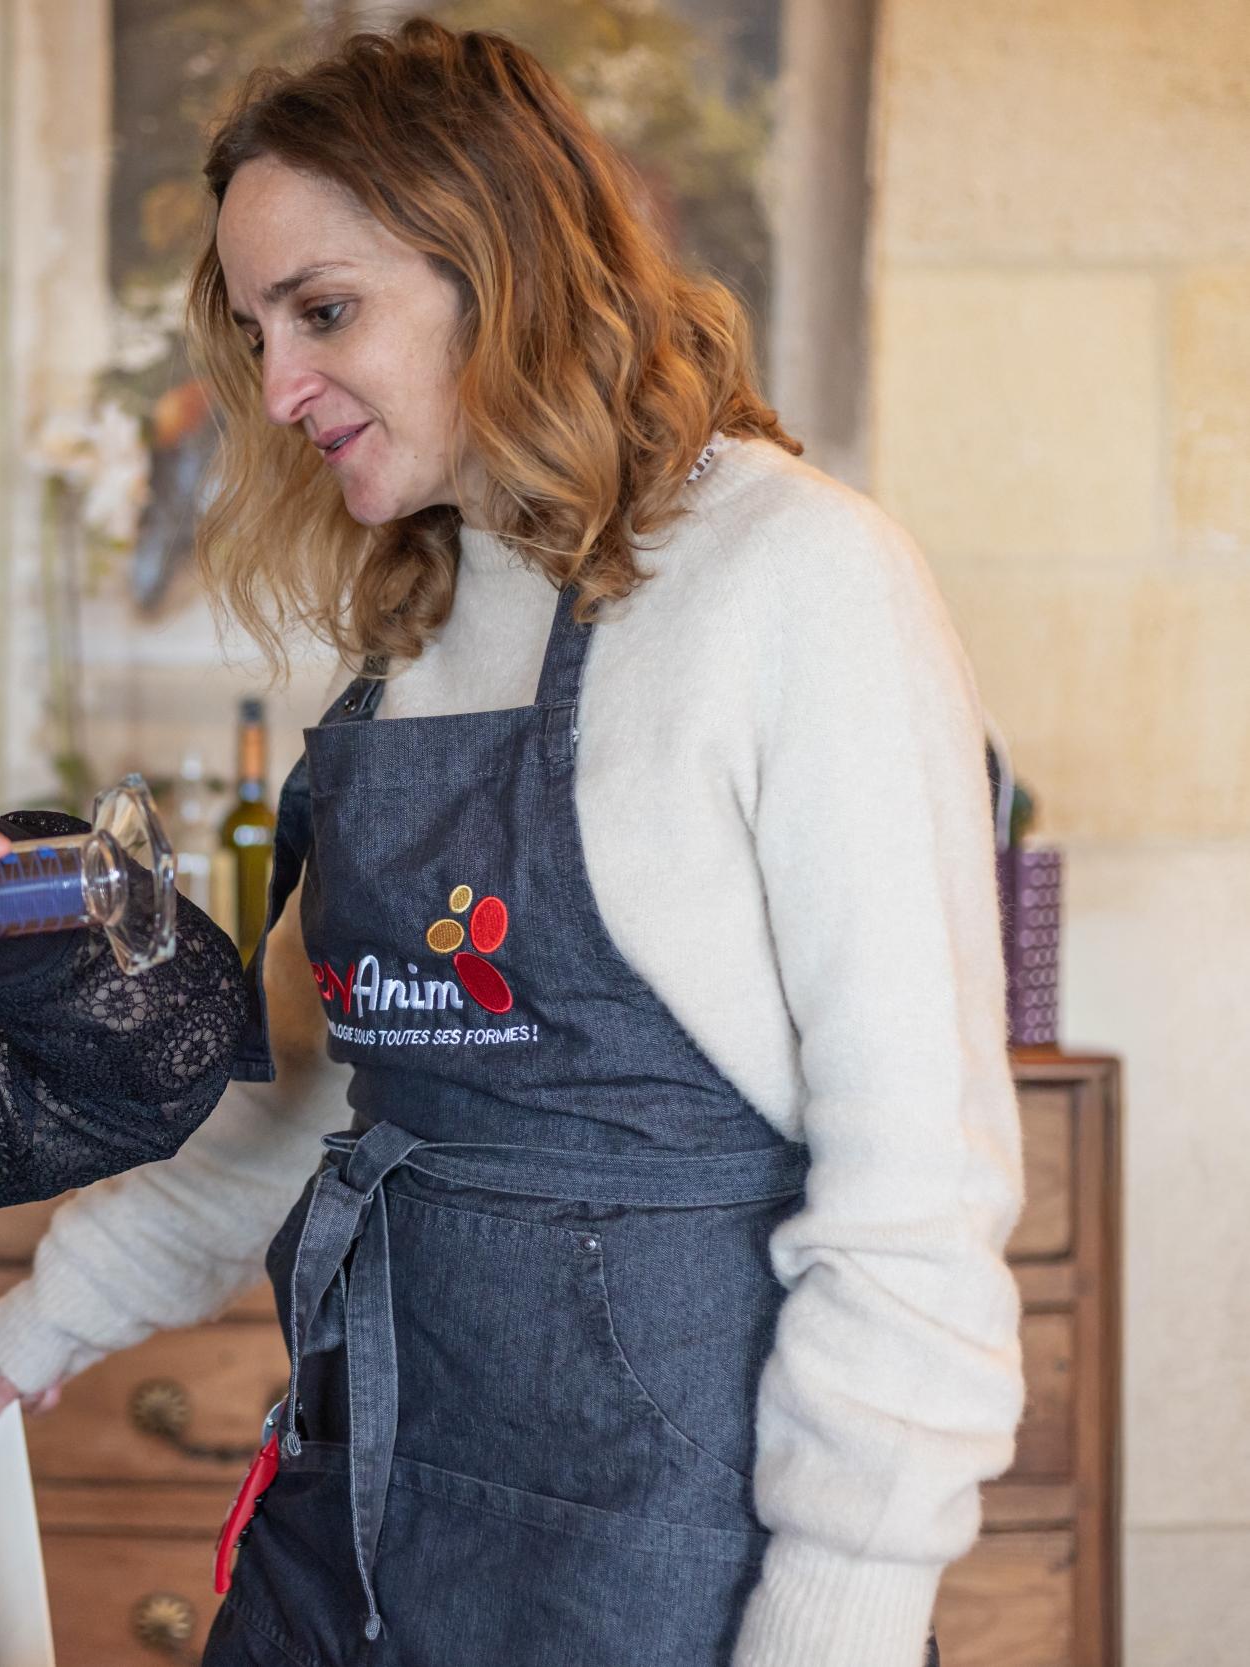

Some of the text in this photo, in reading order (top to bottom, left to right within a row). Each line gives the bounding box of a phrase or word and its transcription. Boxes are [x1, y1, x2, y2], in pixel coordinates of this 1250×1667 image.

[354, 1027, 376, 1045] SOUS
[378, 1029, 431, 1046] TOUTES
[432, 1028, 462, 1045] SES
